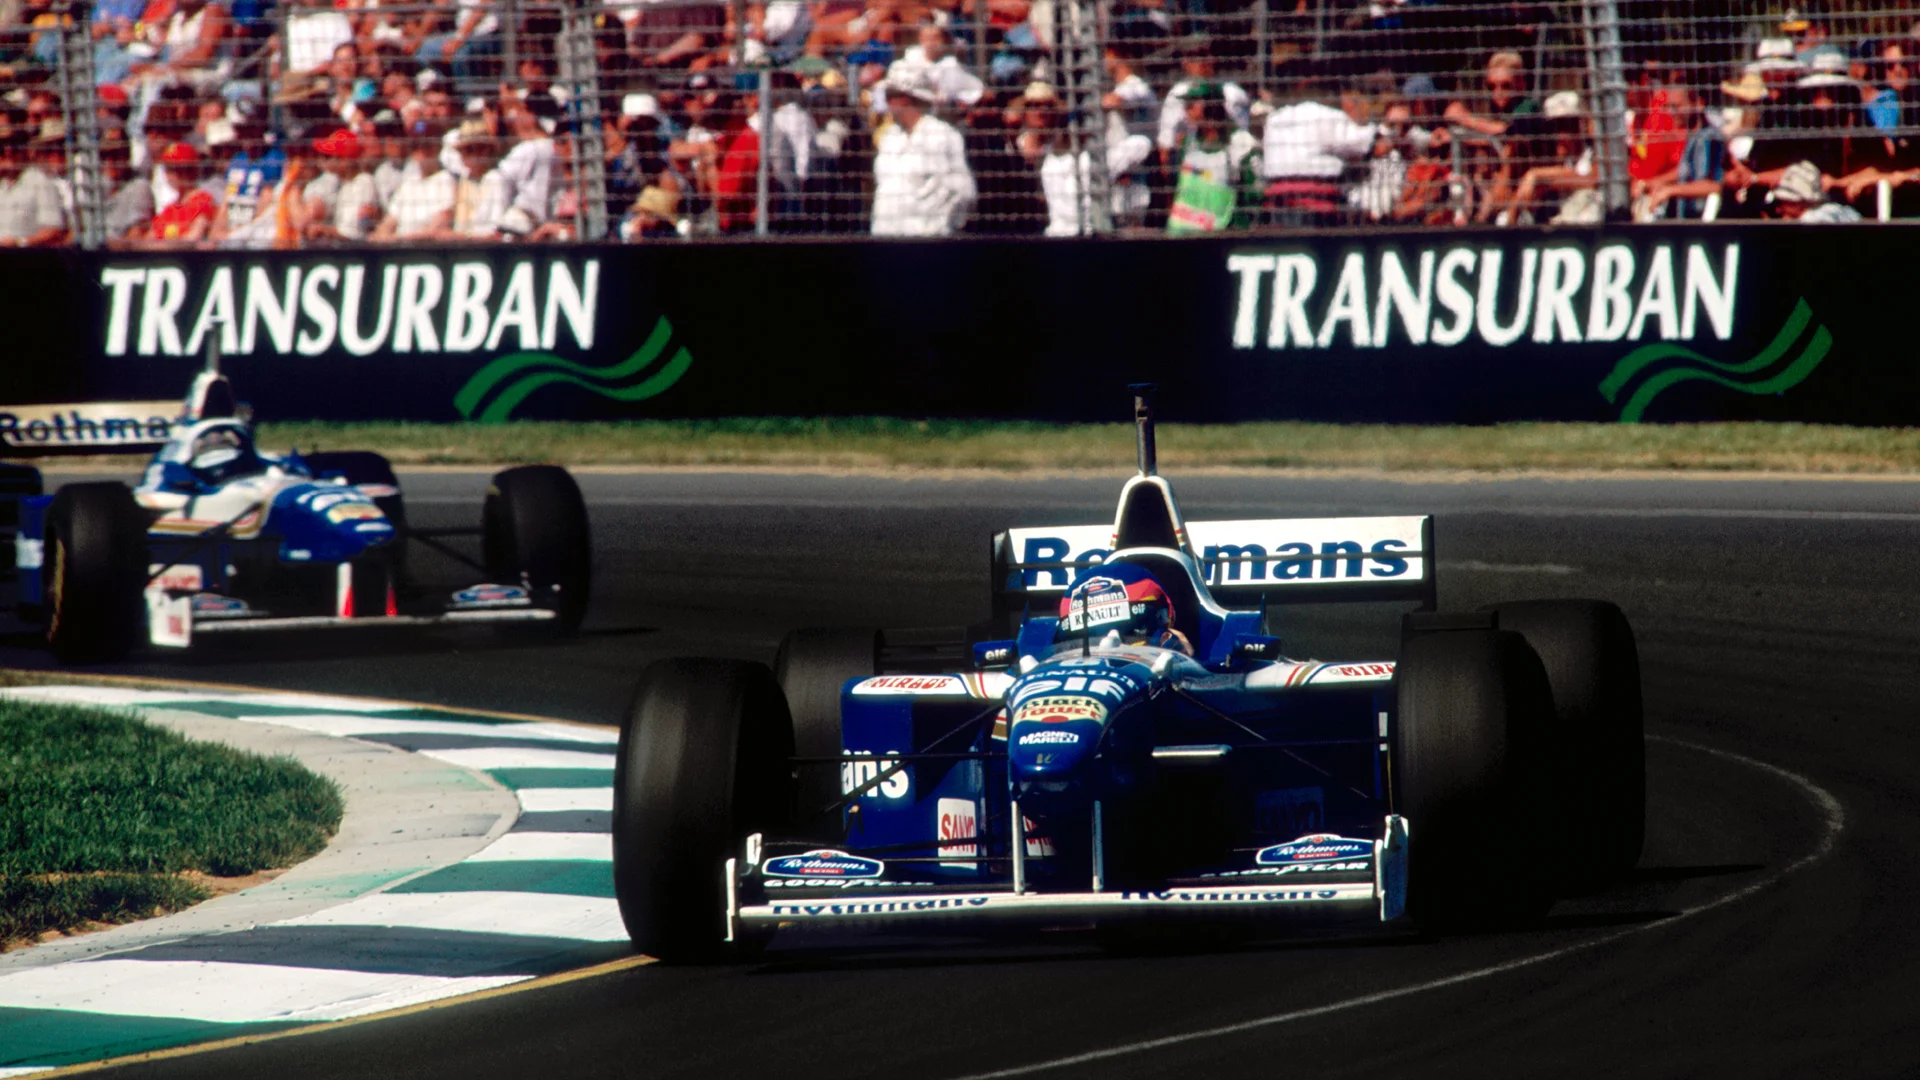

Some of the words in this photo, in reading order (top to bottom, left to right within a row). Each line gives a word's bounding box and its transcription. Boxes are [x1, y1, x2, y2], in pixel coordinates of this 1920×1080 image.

[1227, 243, 1740, 349] TRANSURBAN
[101, 259, 600, 357] TRANSURBAN
[1024, 537, 1409, 586] Romans
[1071, 591, 1124, 611] Rohmans
[1131, 603, 1146, 615] elf
[1074, 605, 1121, 626] RNAULT
[985, 648, 1008, 661] elf
[1012, 677, 1126, 709] elf
[1021, 698, 1101, 712] Black
[1273, 844, 1362, 857] Rothmans
[779, 857, 870, 870] Rothmans
